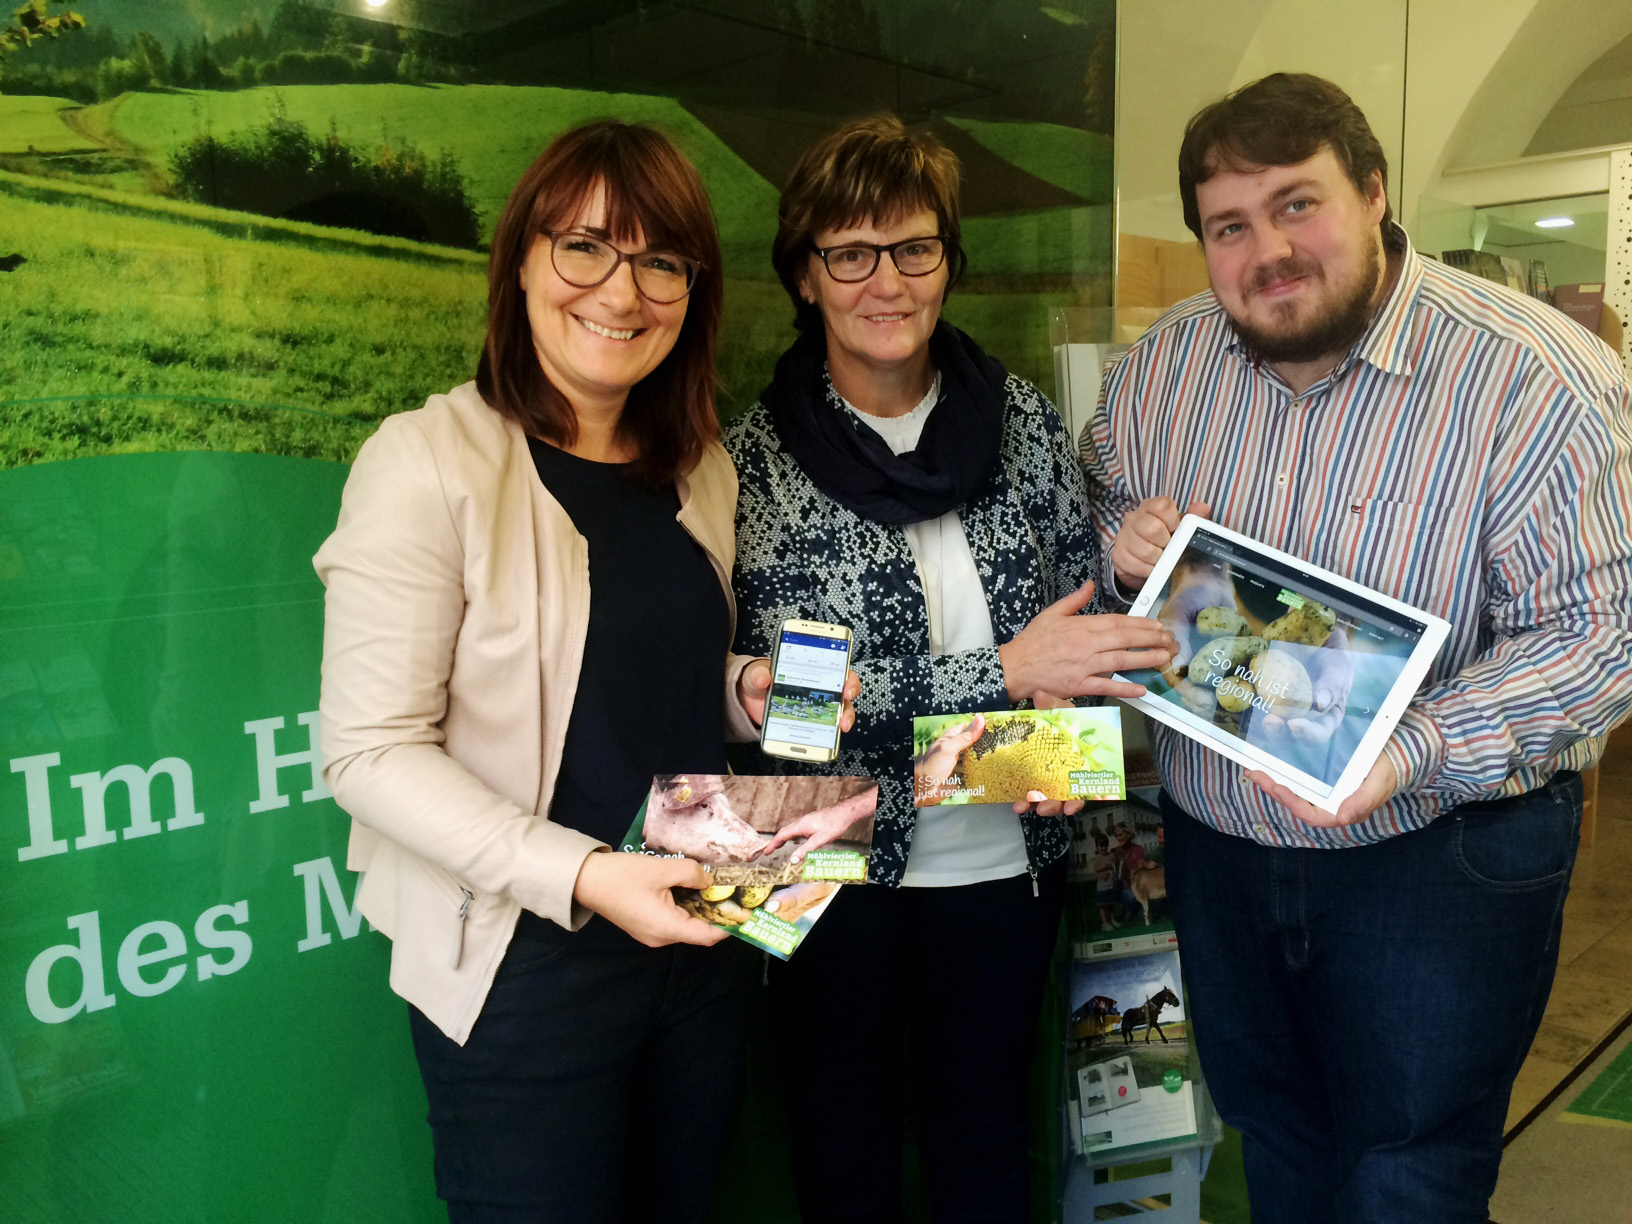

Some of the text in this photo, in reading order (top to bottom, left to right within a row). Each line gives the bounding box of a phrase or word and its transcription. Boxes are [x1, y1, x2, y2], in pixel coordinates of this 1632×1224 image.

[1208, 649, 1290, 698] So nah ist
[1204, 671, 1276, 714] regional!
[924, 775, 940, 787] So
[942, 773, 962, 785] nah
[940, 785, 985, 799] regional!
[1070, 784, 1121, 795] Bauern
[10, 752, 205, 862] Im
[806, 852, 857, 861] Mühlviertler
[815, 859, 863, 867] Kernland
[806, 866, 862, 877] Bauern
[753, 909, 797, 933] Mühlviertler
[755, 918, 799, 943] Kernland
[742, 921, 794, 953] Bauern
[25, 899, 253, 1024] des
